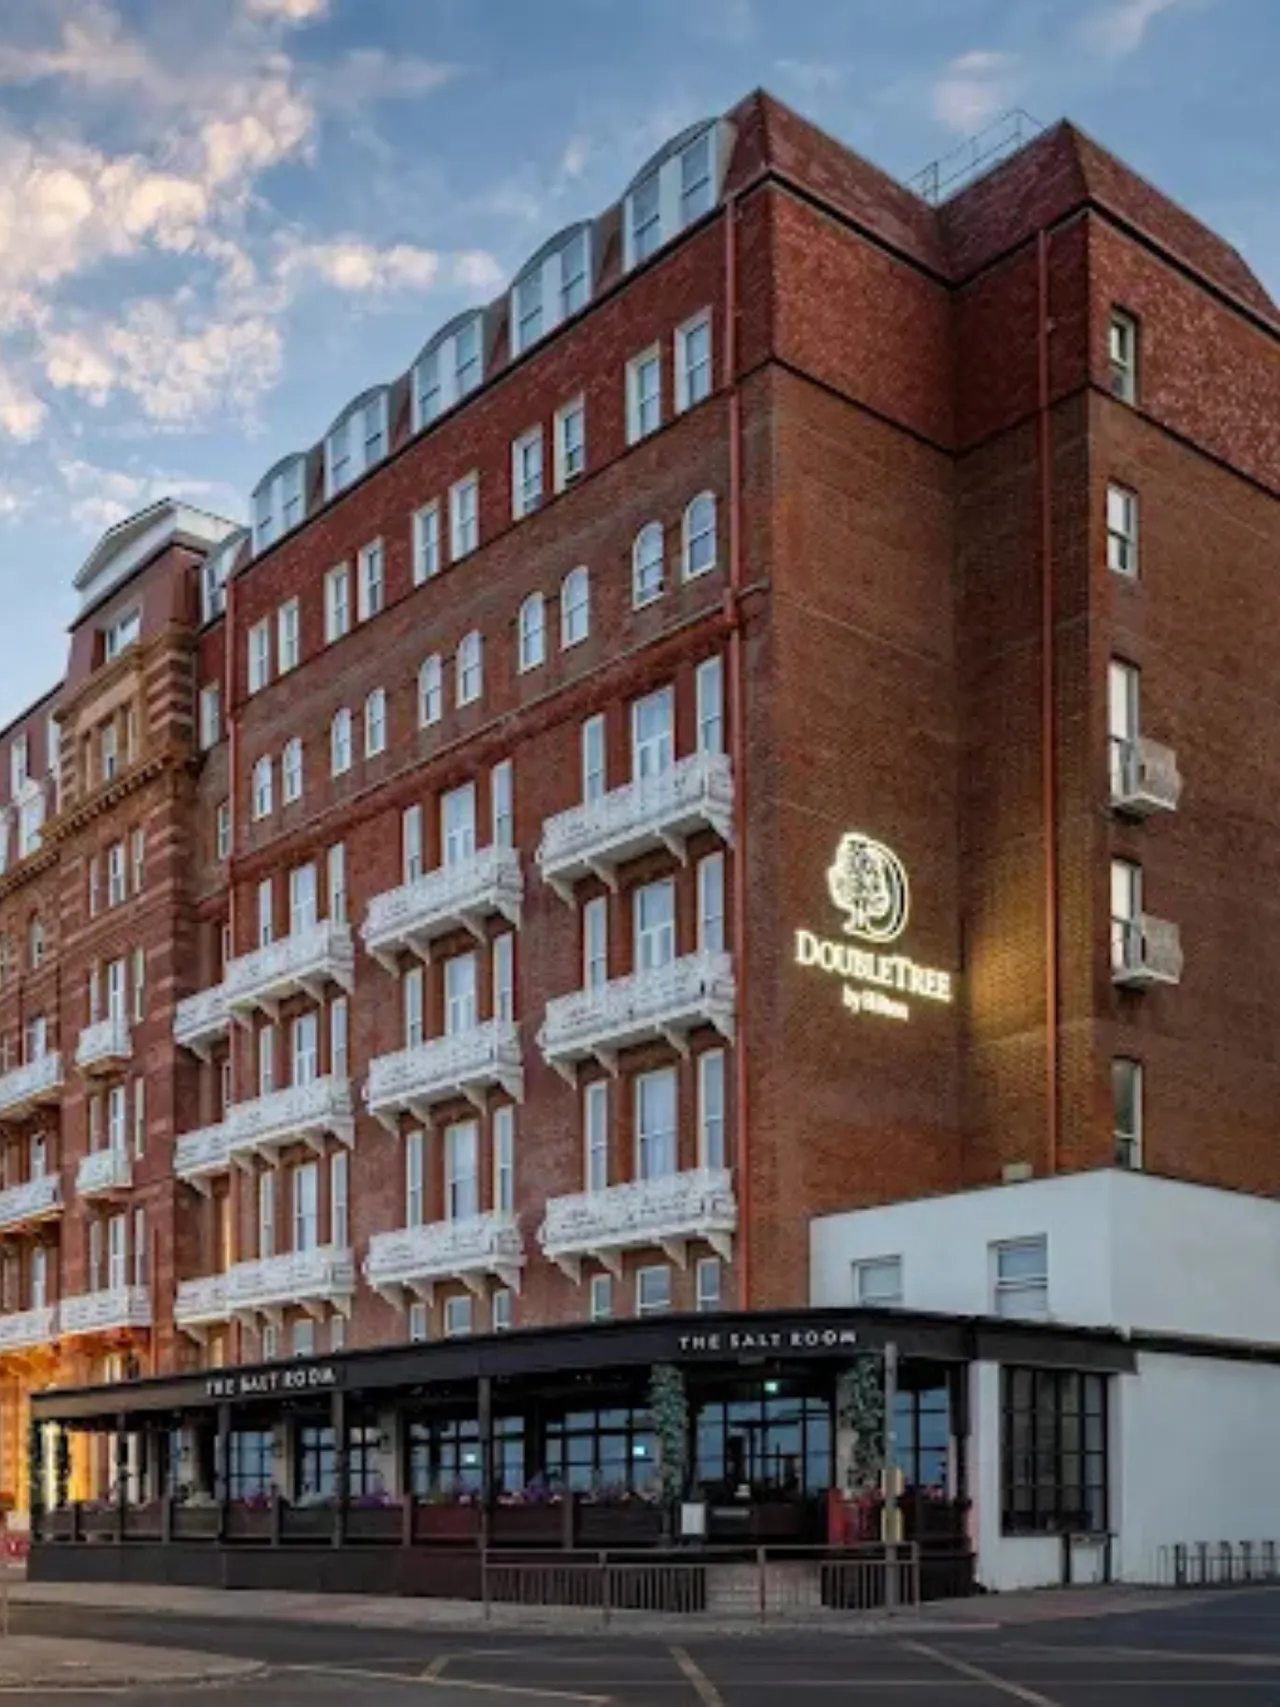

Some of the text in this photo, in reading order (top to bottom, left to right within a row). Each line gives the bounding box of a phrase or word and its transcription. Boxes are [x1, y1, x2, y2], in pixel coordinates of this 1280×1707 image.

[679, 1330, 856, 1350] THE SALT ROOM
[206, 1378, 234, 1396] THE
